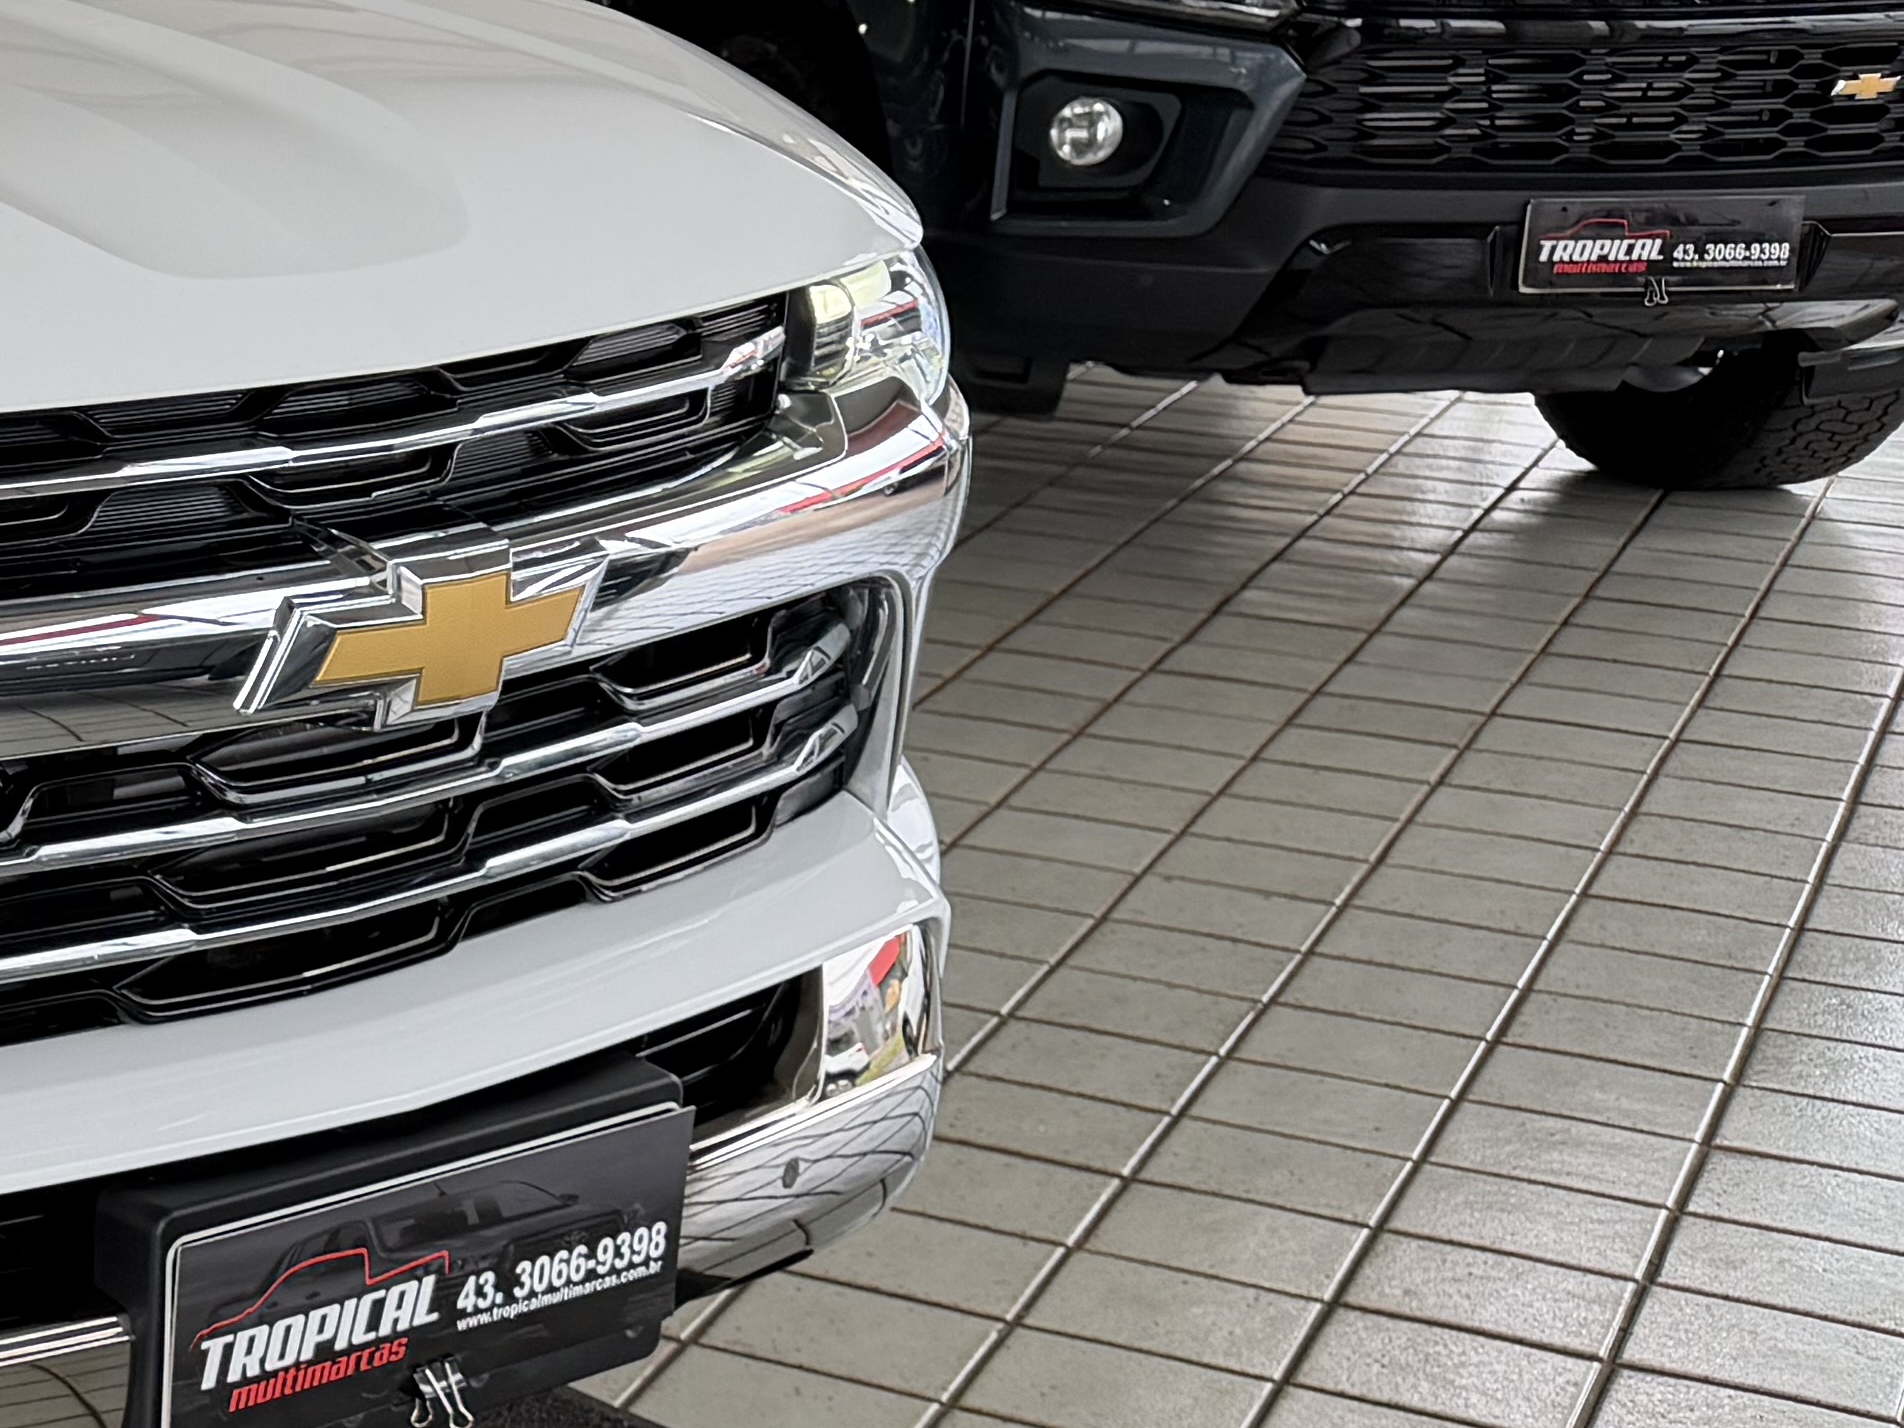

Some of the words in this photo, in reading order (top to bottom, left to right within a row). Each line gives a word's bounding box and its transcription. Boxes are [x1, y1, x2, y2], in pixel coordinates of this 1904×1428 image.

[1539, 237, 1665, 263] TROPICAL
[1704, 242, 1791, 261] 3066-9398
[456, 1270, 504, 1314] 43.
[513, 1221, 668, 1299] 3066-9398
[456, 1259, 663, 1332] www.tropicalmultimarcas.com.br
[200, 1273, 440, 1391] TROPICAL
[228, 1335, 409, 1413] multimarcas
